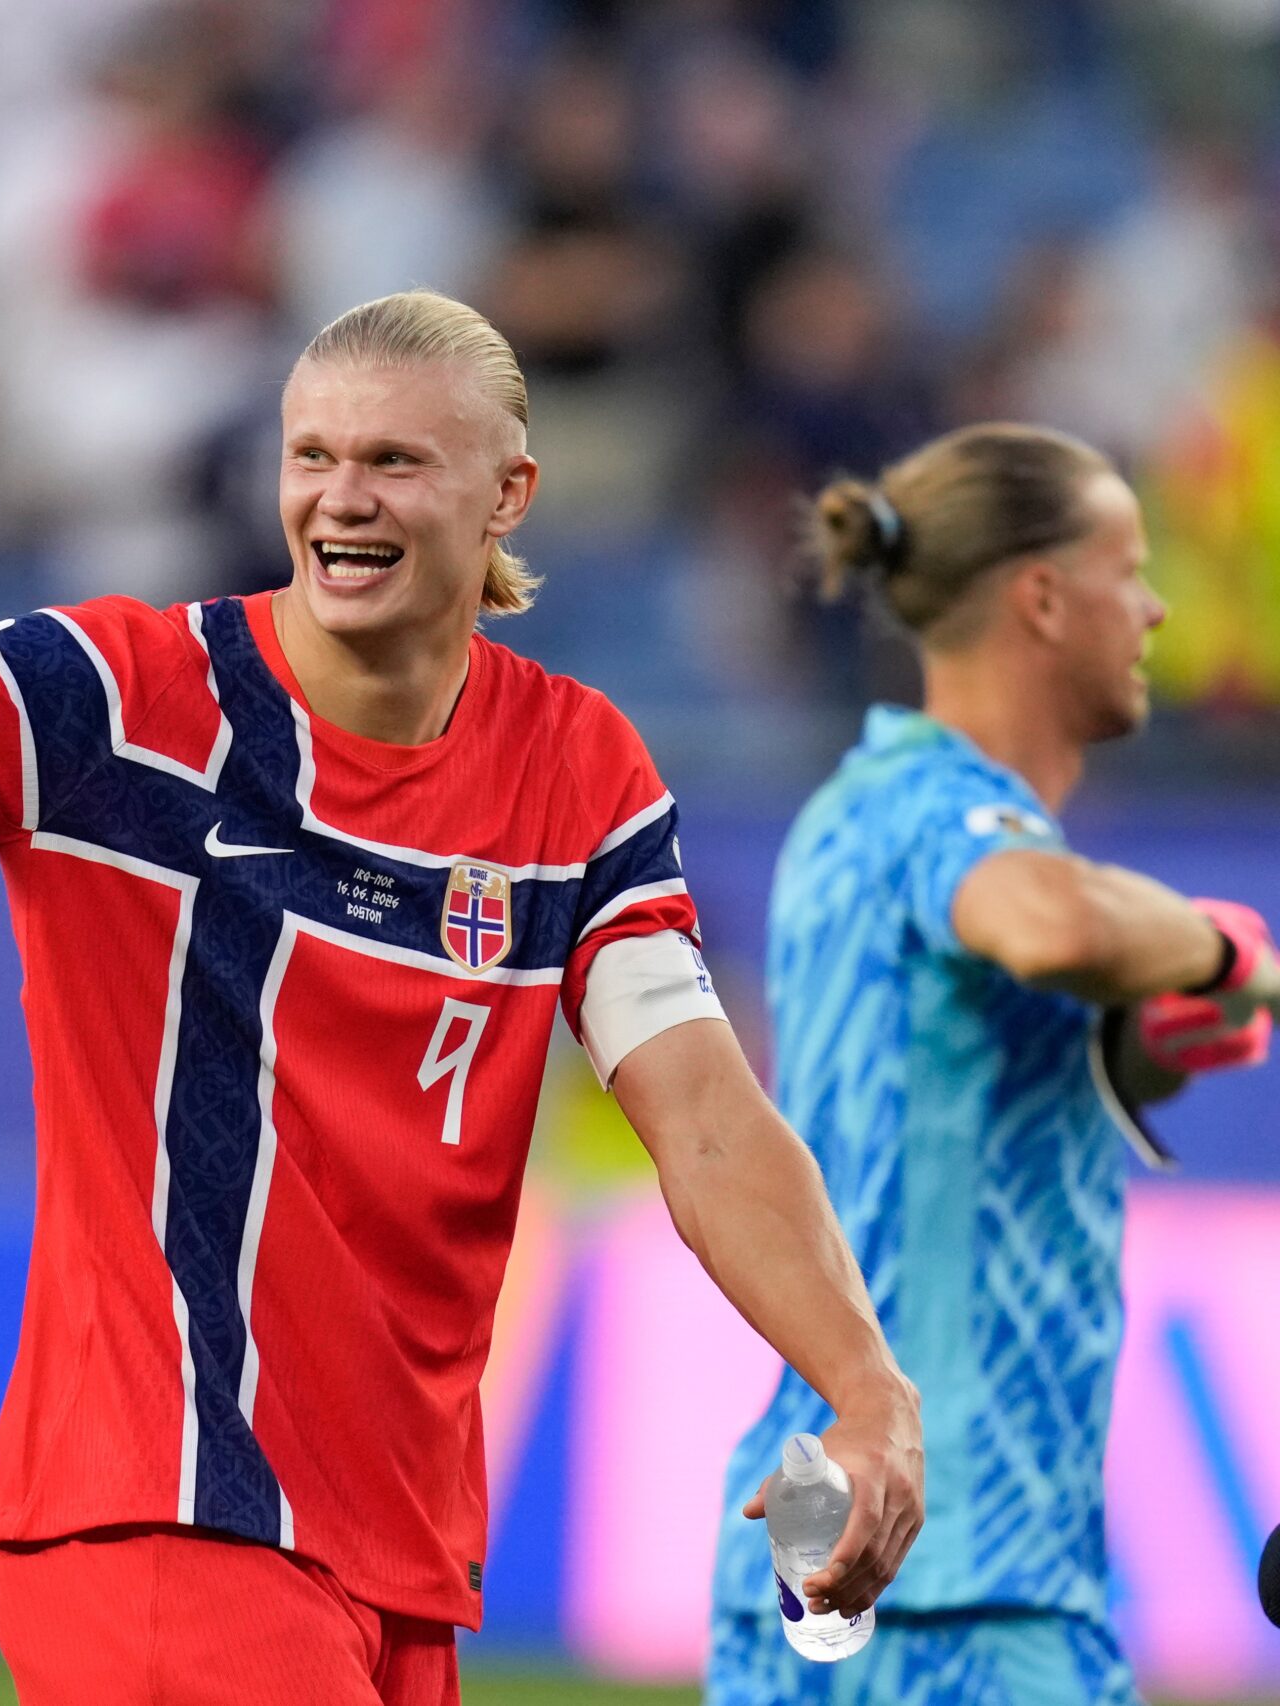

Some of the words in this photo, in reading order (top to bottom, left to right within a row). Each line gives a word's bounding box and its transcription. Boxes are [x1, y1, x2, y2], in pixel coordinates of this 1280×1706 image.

[353, 868, 395, 889] IRQ-NOR
[469, 868, 488, 881] NORGE
[346, 902, 382, 924] BOSTON
[417, 996, 491, 1146] 9
